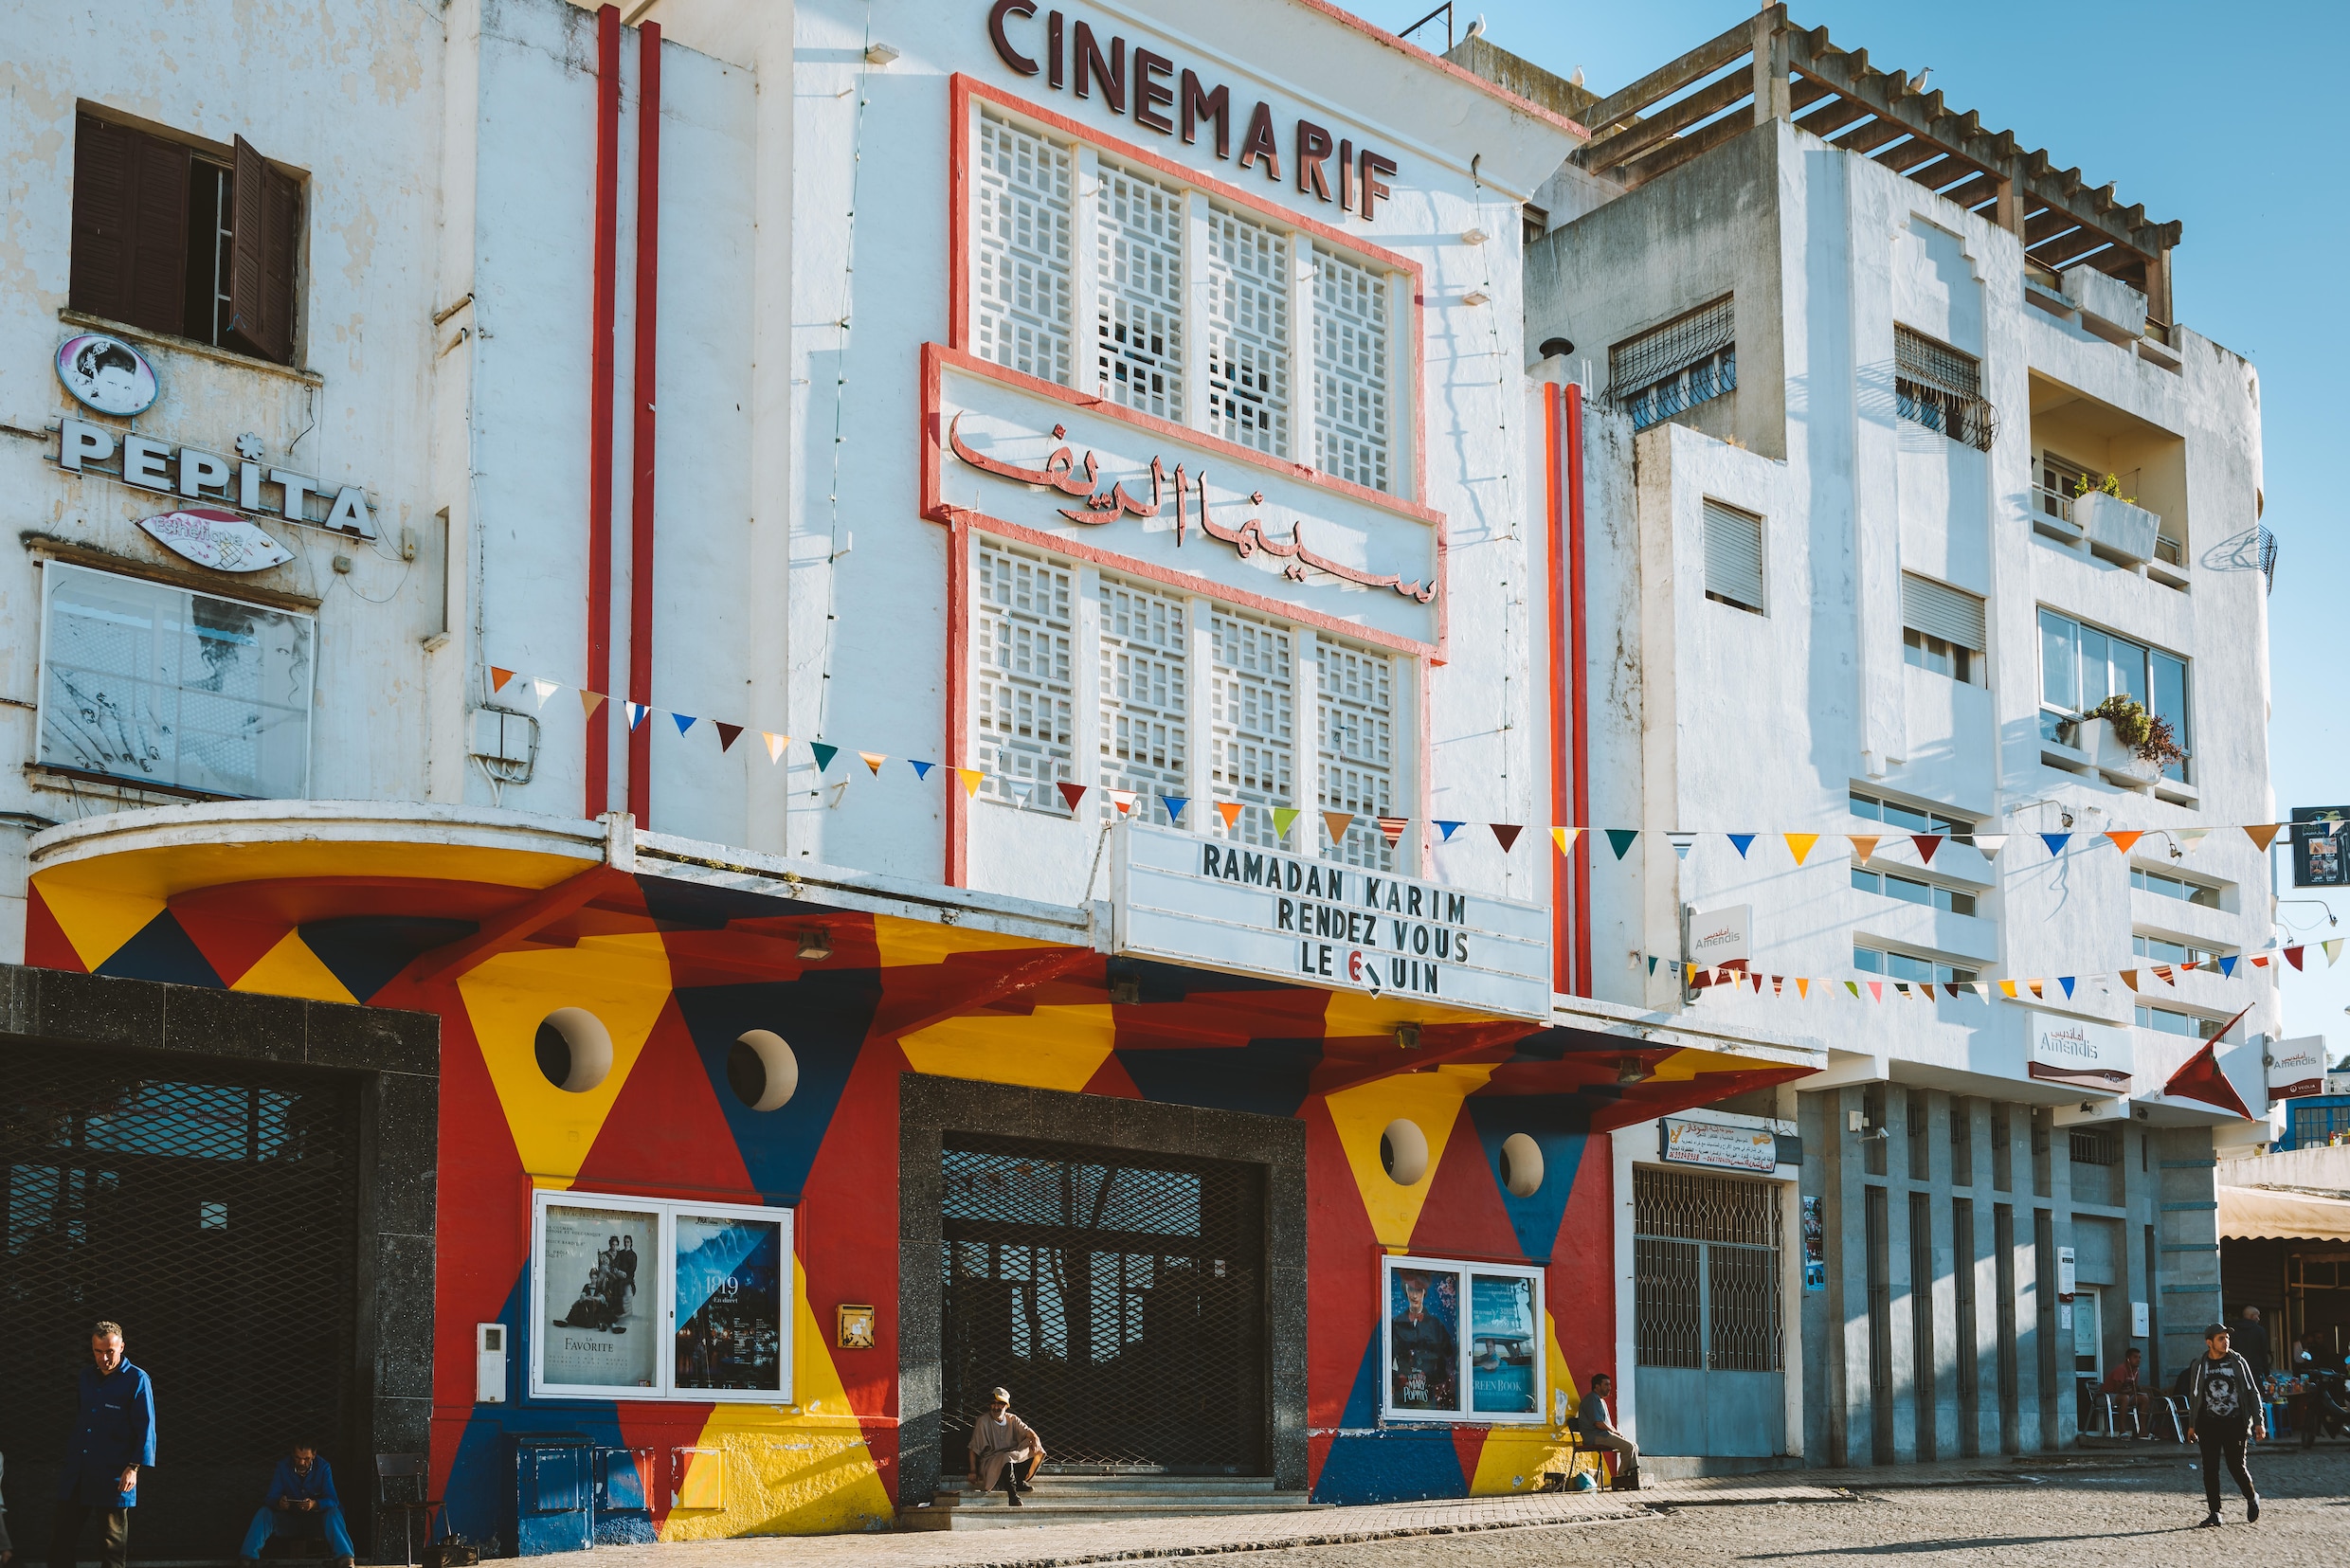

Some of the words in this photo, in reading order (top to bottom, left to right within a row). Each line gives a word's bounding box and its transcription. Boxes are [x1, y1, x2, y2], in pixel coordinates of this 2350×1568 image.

[949, 410, 1189, 548] الريف
[1200, 470, 1438, 604] سينما
[1203, 843, 1344, 901] RAMADAN
[1365, 875, 1467, 926] KARIM
[1277, 896, 1377, 946] RENDEZ
[1393, 919, 1469, 963] VOUS
[1695, 932, 1741, 950] Amendis
[1302, 941, 1333, 977] LE
[2040, 1032, 2098, 1059] Amendis
[2273, 1055, 2317, 1070] Amendis
[565, 1337, 614, 1353] FAVORITE
[1498, 1379, 1522, 1392] BOOK
